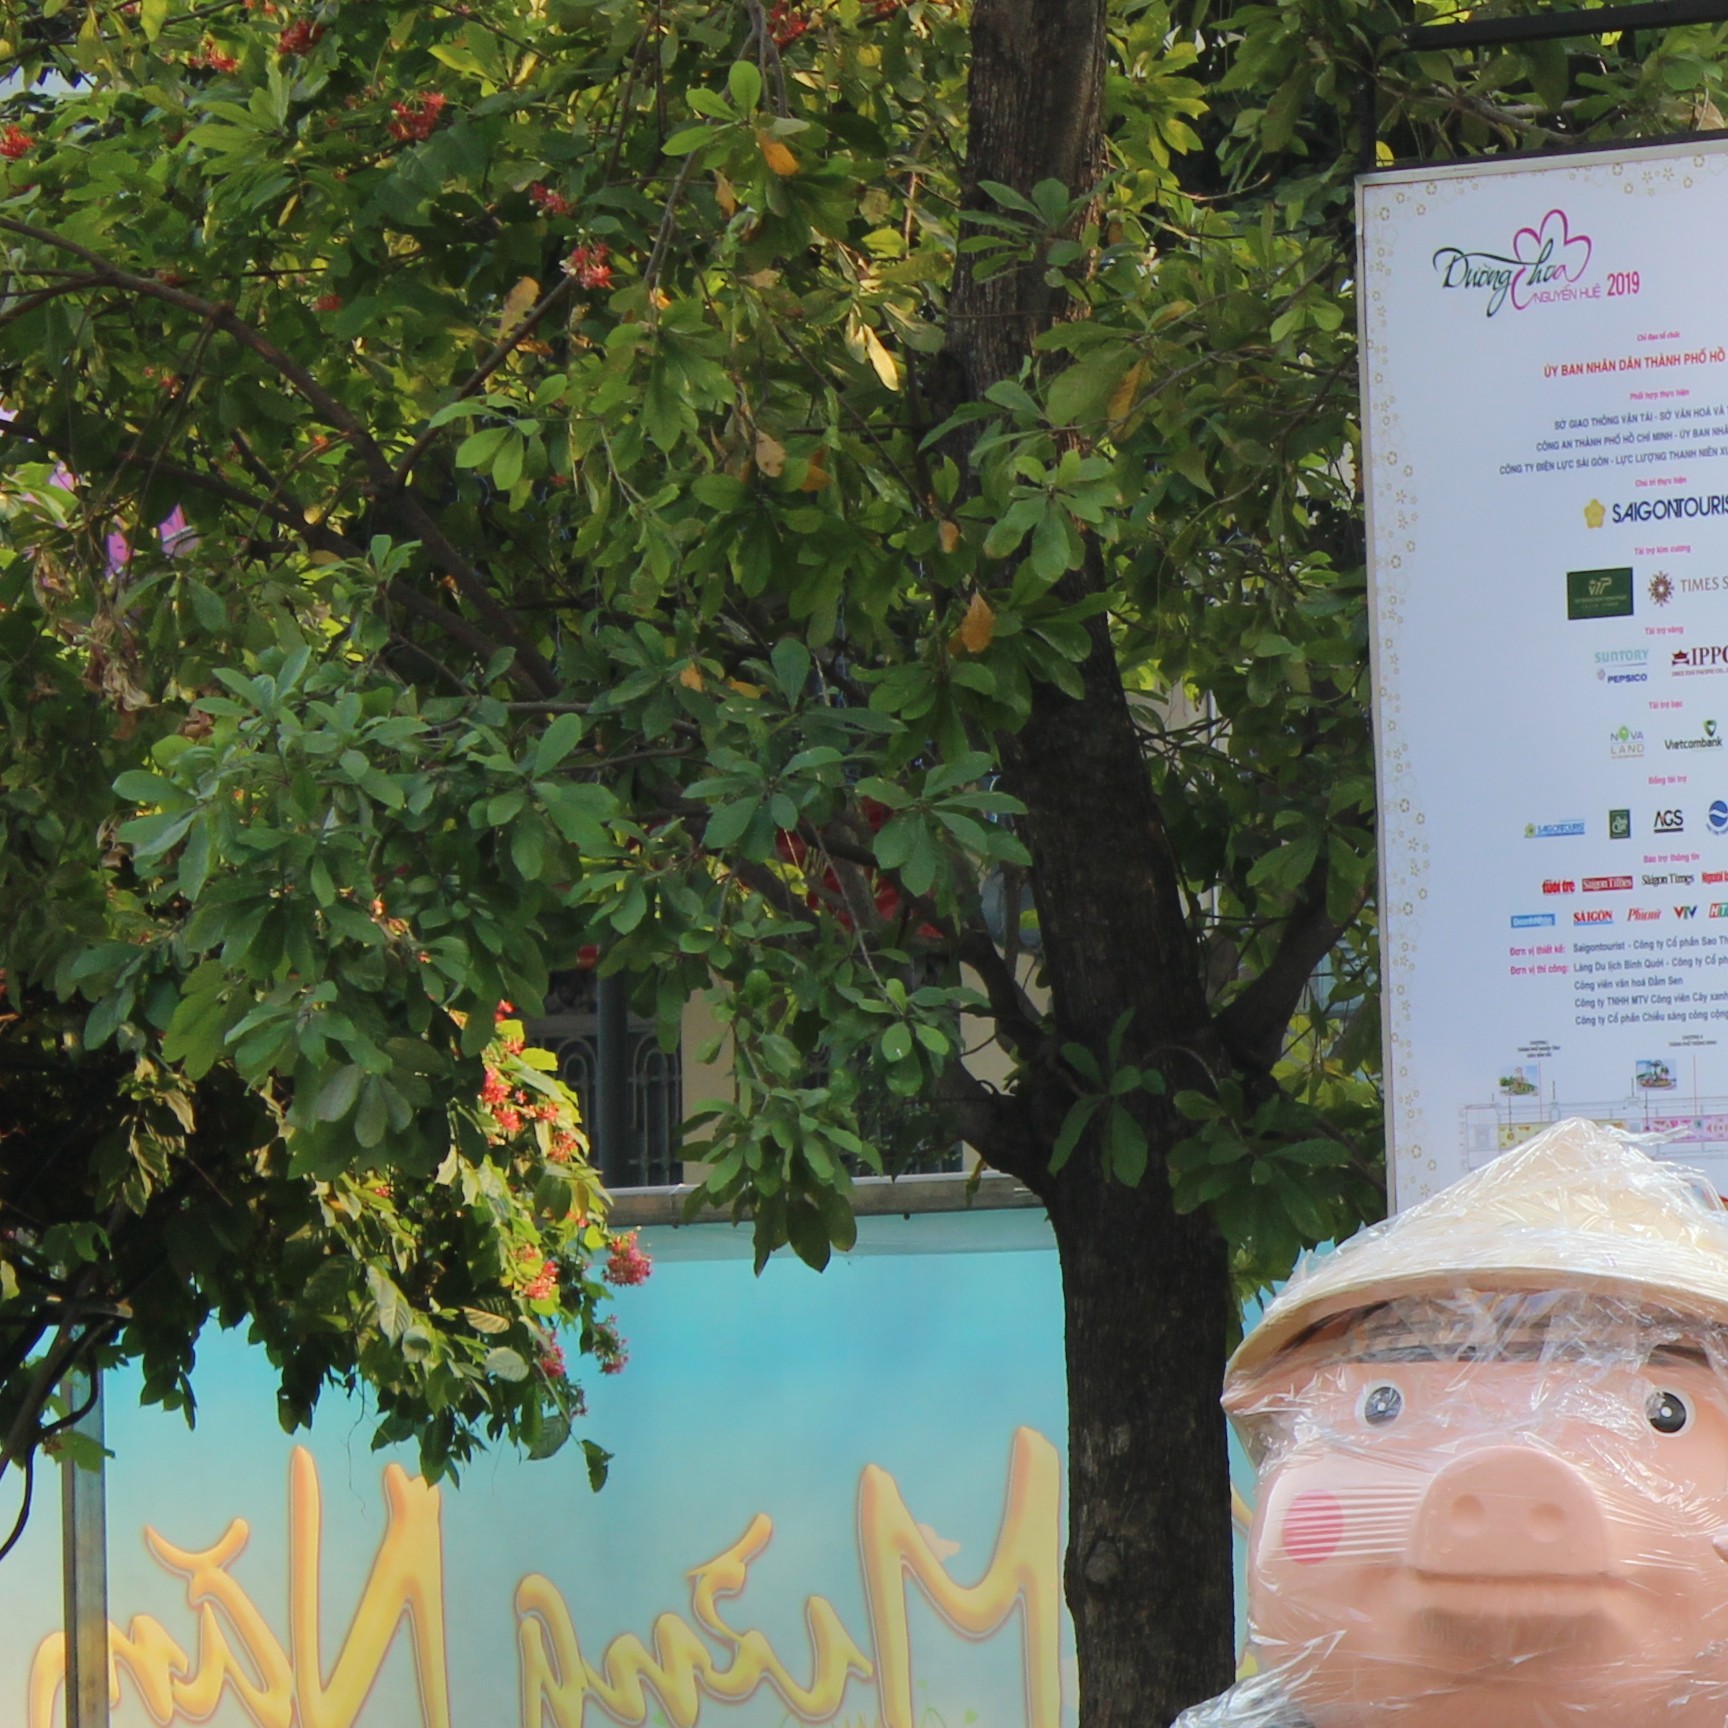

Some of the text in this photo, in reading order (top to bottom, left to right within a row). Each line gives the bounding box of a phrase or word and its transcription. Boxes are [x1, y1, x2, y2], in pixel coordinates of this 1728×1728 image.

[1607, 271, 1640, 297] 2019
[1561, 362, 1584, 377] BAN
[1586, 357, 1616, 374] NHÂN
[1618, 354, 1642, 372] DÂN
[1645, 352, 1681, 369] THÀNH
[1683, 347, 1707, 365] PHỐ
[1680, 577, 1719, 592] TIMES
[1664, 736, 1723, 751] Vietcombank
